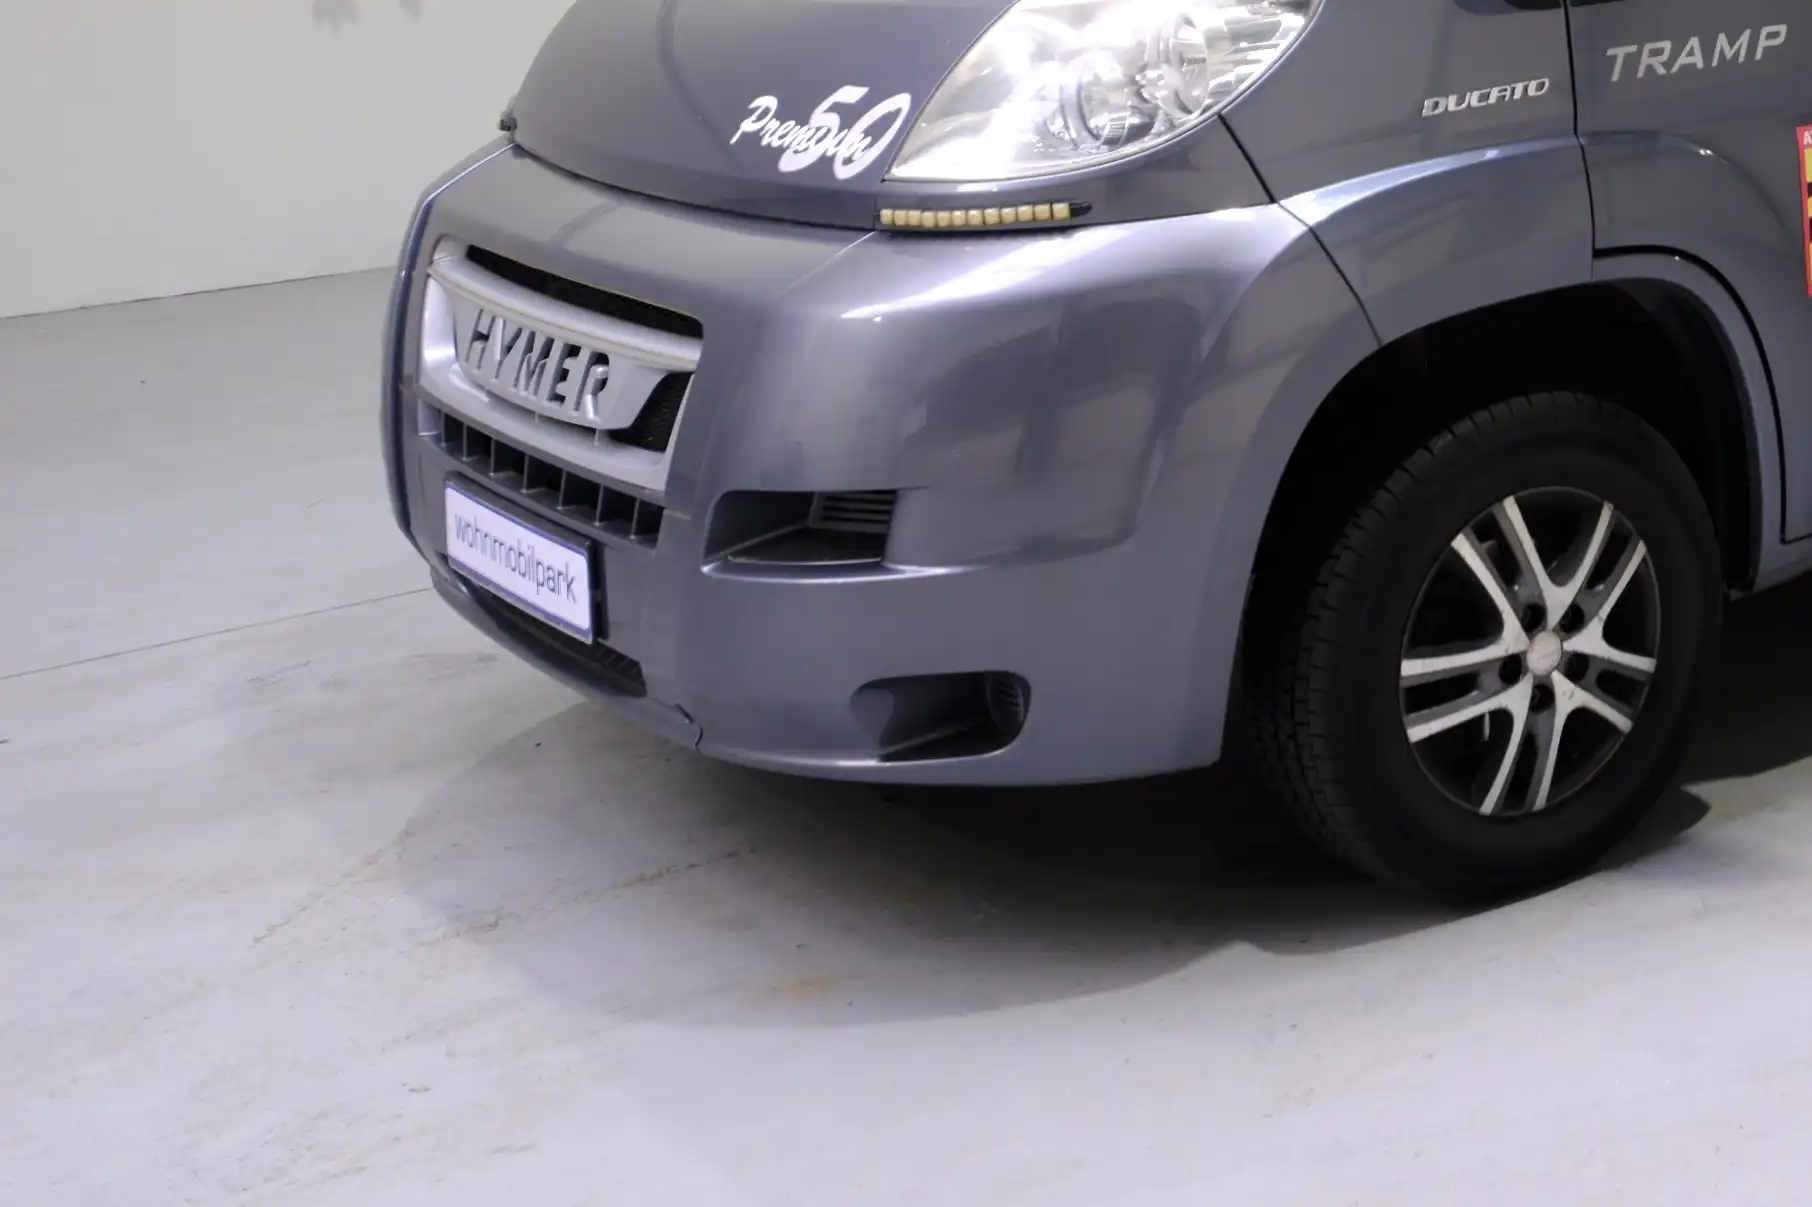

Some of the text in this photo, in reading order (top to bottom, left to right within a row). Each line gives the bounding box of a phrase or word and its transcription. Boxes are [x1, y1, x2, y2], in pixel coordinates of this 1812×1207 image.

[1421, 78, 1550, 118] DUCATO
[1605, 24, 1788, 83] TRAMP
[777, 84, 912, 181] 50
[464, 308, 611, 423] HYMER
[454, 513, 579, 605] wohnmobilpark
